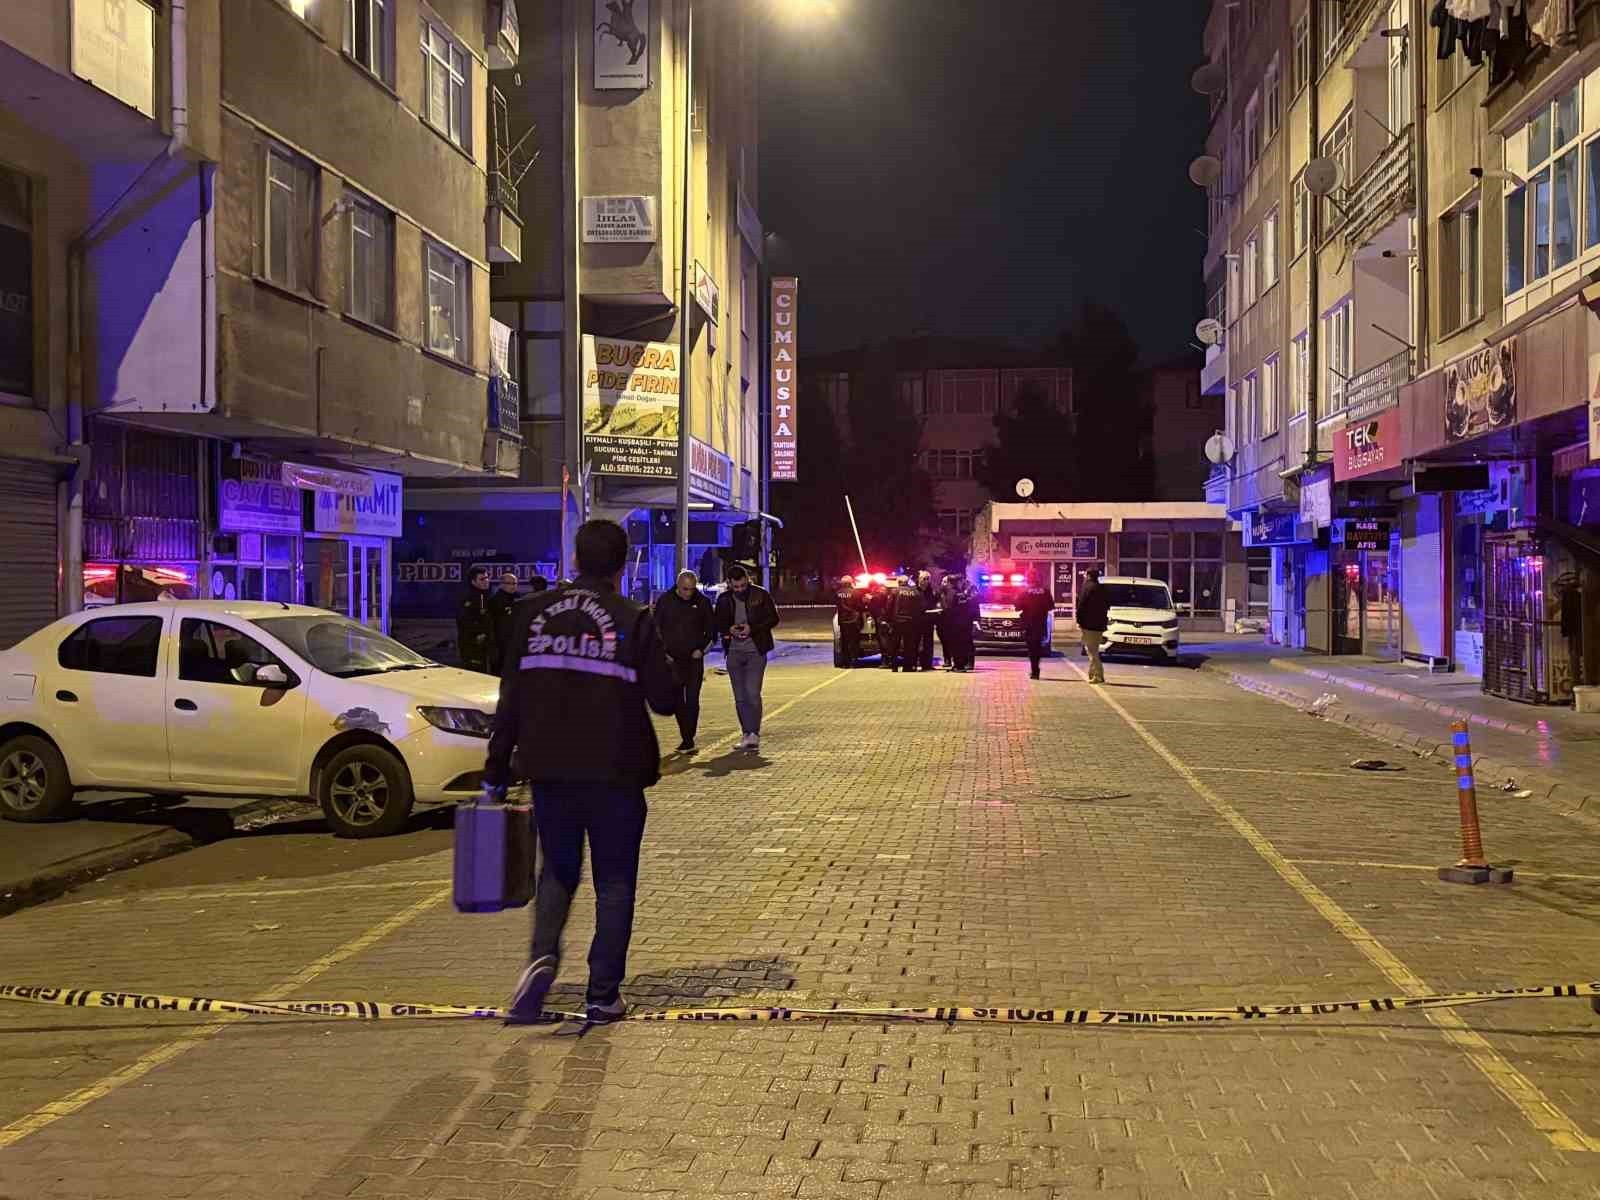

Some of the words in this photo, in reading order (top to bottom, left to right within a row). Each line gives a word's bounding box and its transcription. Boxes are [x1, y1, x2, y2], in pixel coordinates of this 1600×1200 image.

[774, 294, 792, 362] CUMA
[596, 343, 676, 371] BUĞRA
[586, 368, 629, 390] PİDE
[775, 368, 792, 437] USTA
[1346, 423, 1371, 450] TEK
[399, 559, 463, 583] PİDE
